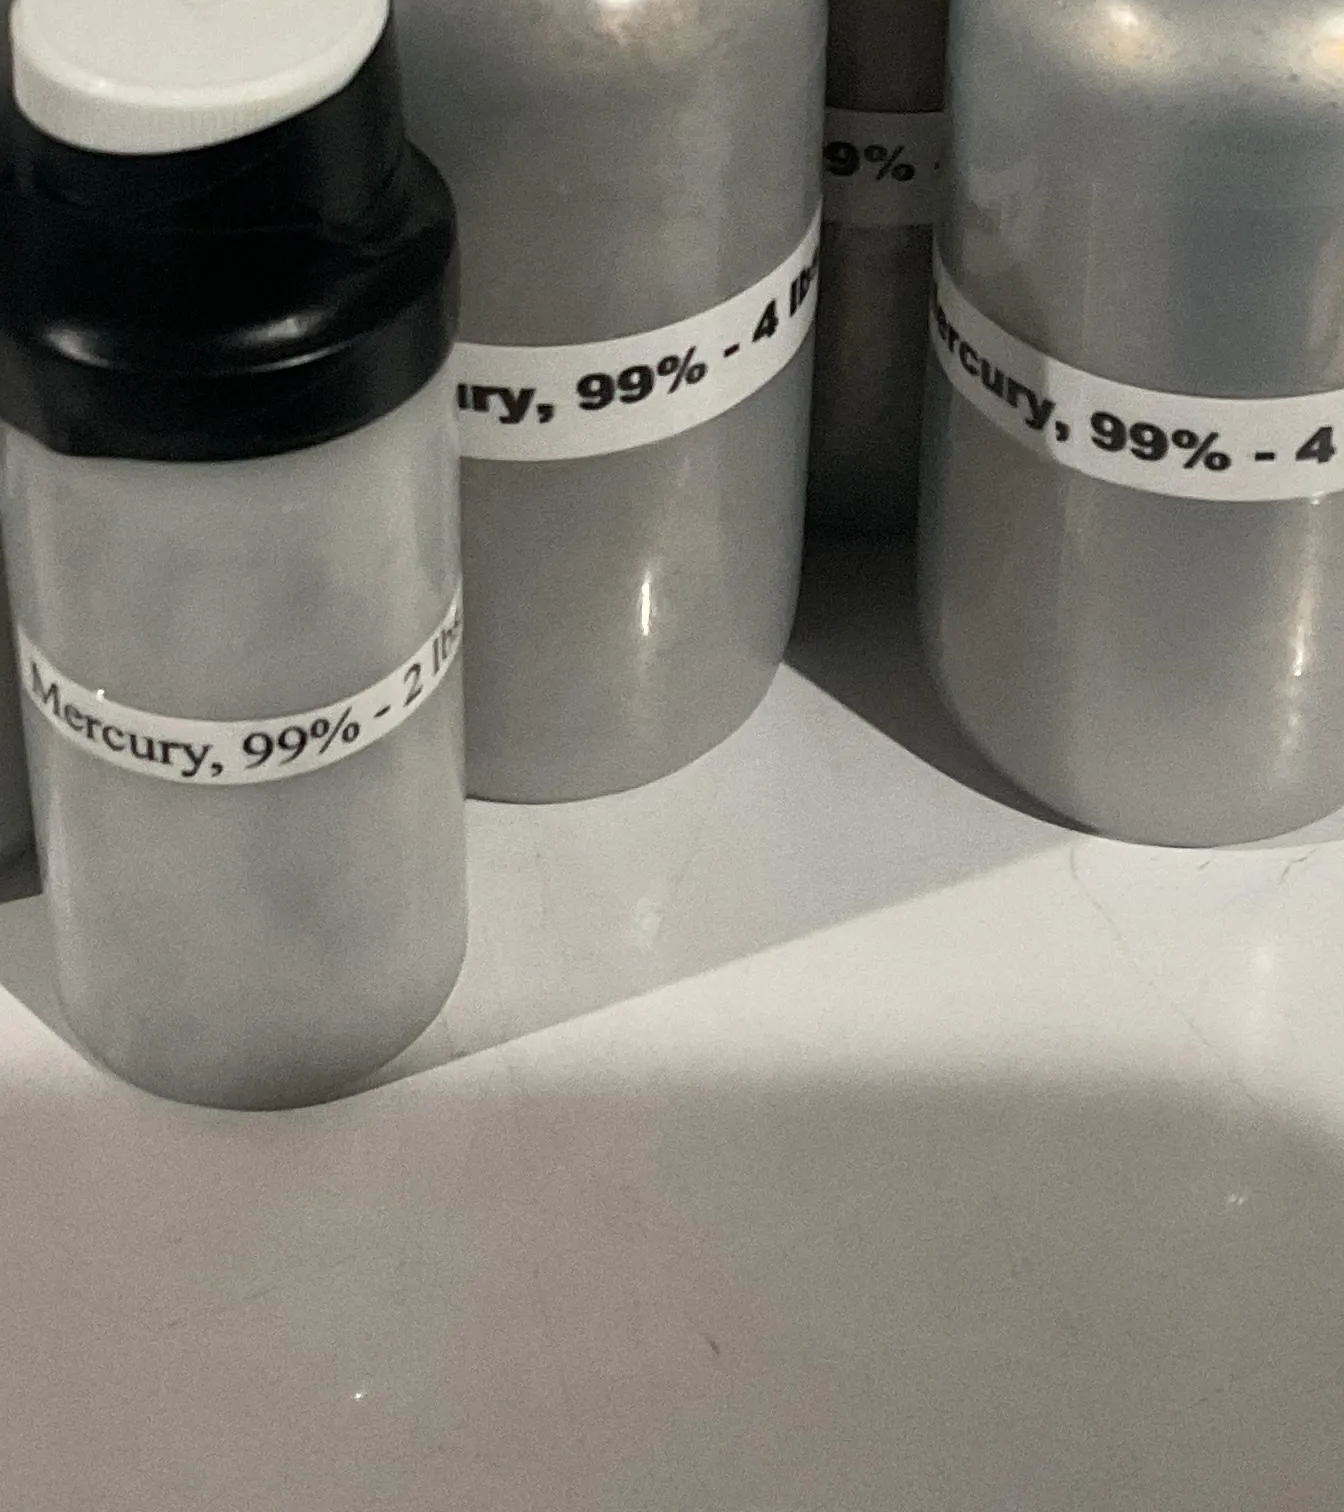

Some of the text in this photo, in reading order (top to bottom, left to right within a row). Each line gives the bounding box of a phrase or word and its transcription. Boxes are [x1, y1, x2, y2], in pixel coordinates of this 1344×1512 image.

[577, 347, 709, 411] 99%
[723, 343, 740, 358] -
[752, 298, 779, 342] 4
[935, 298, 1069, 443] ercury,
[1090, 411, 1232, 472] 99%
[1255, 453, 1275, 462] -
[1296, 426, 1336, 464] 4
[29, 662, 224, 777] Mercury,
[242, 707, 361, 769] 99%
[374, 707, 391, 719] -
[403, 662, 424, 707] 2
